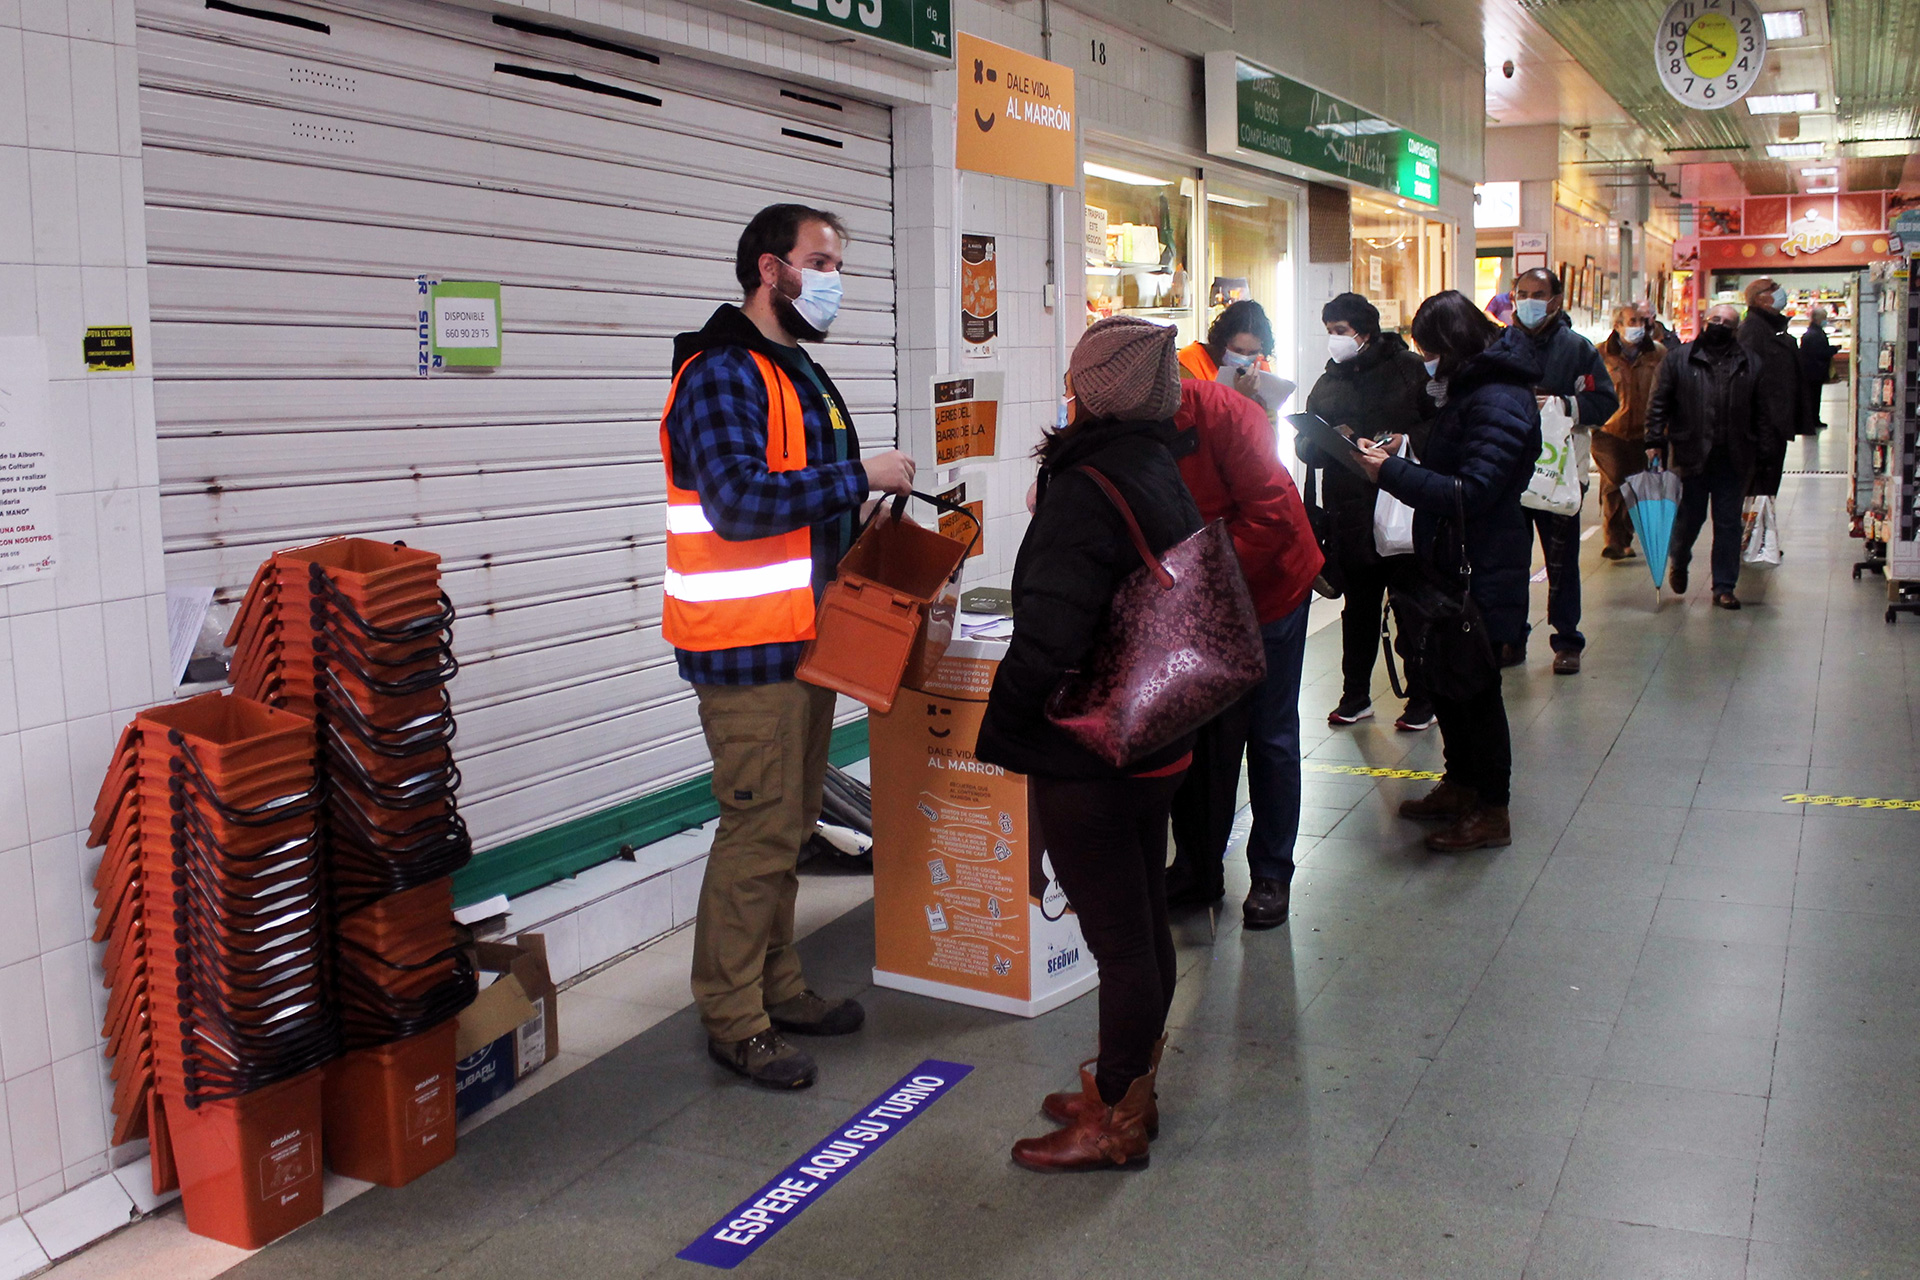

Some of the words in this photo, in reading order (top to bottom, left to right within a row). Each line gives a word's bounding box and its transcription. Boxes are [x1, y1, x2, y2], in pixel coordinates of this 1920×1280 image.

[927, 7, 937, 21] de
[1684, 3, 1694, 18] 11
[1670, 22, 1686, 37] 10
[1740, 18, 1751, 34] 2
[1666, 40, 1678, 56] 9
[1744, 37, 1754, 52] 3
[1090, 40, 1106, 65] 18
[1670, 59, 1681, 74] 8
[1738, 56, 1748, 71] 4
[1007, 73, 1030, 94] DALE
[1032, 80, 1050, 100] VIDA
[1253, 77, 1280, 100] ZAPATOS
[1684, 78, 1694, 93] 7
[1726, 74, 1738, 89] 5
[1704, 84, 1715, 98] 6
[1006, 97, 1022, 120] AL
[1025, 103, 1071, 131] MARRÓN
[1254, 101, 1278, 125] BOLSOS
[1240, 123, 1292, 156] COMPLEMENTOS
[1782, 232, 1836, 255] Ana
[445, 312, 485, 320] DISPONIBLE
[446, 329, 459, 338] 660
[460, 329, 469, 338] 90
[471, 329, 479, 338] 29
[481, 329, 489, 338] 75
[936, 408, 956, 425] ¿ERES
[972, 424, 985, 435] LA
[27, 485, 47, 493] ayuda
[15, 535, 53, 544] NOSOTROS.
[928, 746, 952, 757] DALE
[928, 757, 944, 769] AL
[1048, 948, 1079, 973] SEGOVIA
[714, 1178, 819, 1246] ESPERE
[799, 1140, 866, 1180] AQUI
[844, 1120, 890, 1142] SU
[868, 1075, 945, 1120] TURNO
